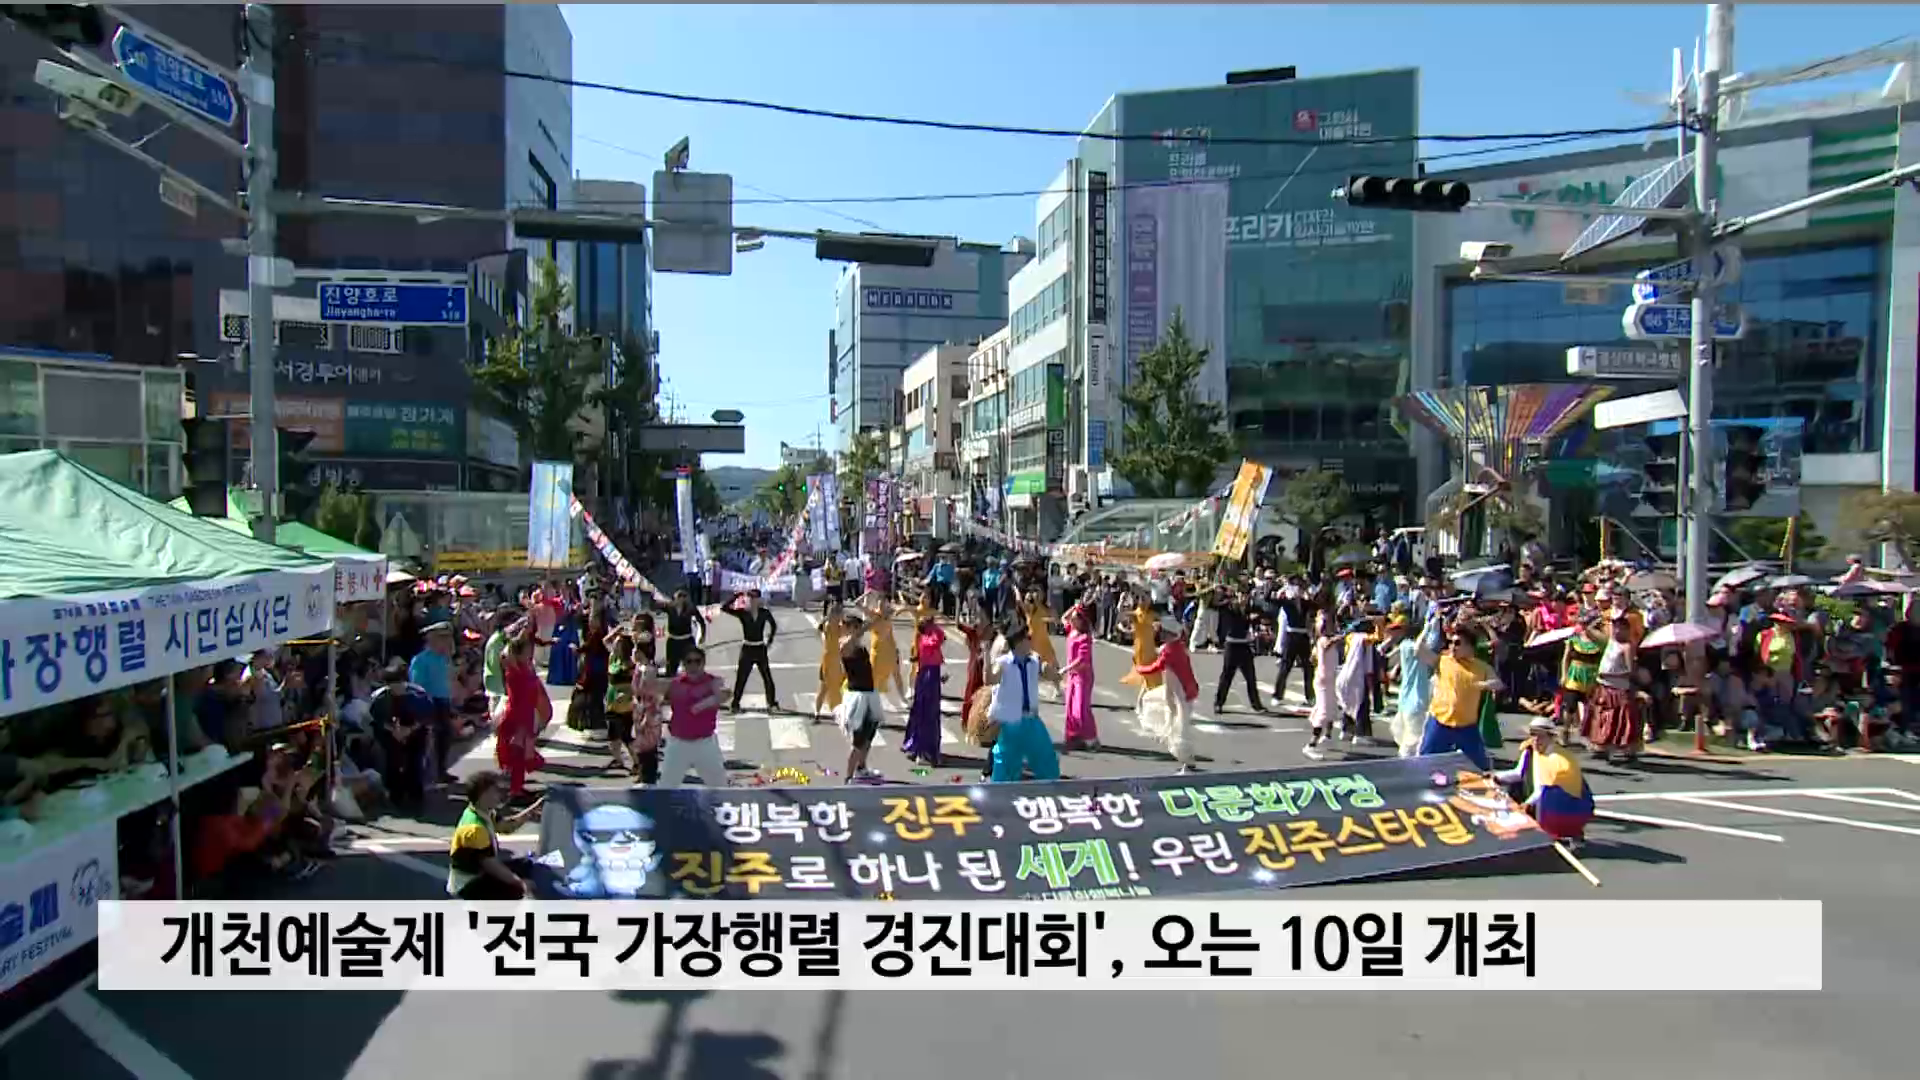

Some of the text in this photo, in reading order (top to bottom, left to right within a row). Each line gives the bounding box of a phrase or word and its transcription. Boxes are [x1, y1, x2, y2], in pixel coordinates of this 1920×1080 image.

[325, 286, 399, 305] 진양호로
[164, 594, 291, 659] 시민심사단
[714, 801, 855, 844] 행복한
[1014, 792, 1145, 835] 행복한
[1157, 773, 1387, 825] 다문화가정
[670, 851, 836, 893] 진주로
[847, 851, 943, 892] 하나
[957, 849, 1007, 892] 된
[1149, 831, 1240, 876] 우린
[1238, 801, 1477, 872] 진주스타일
